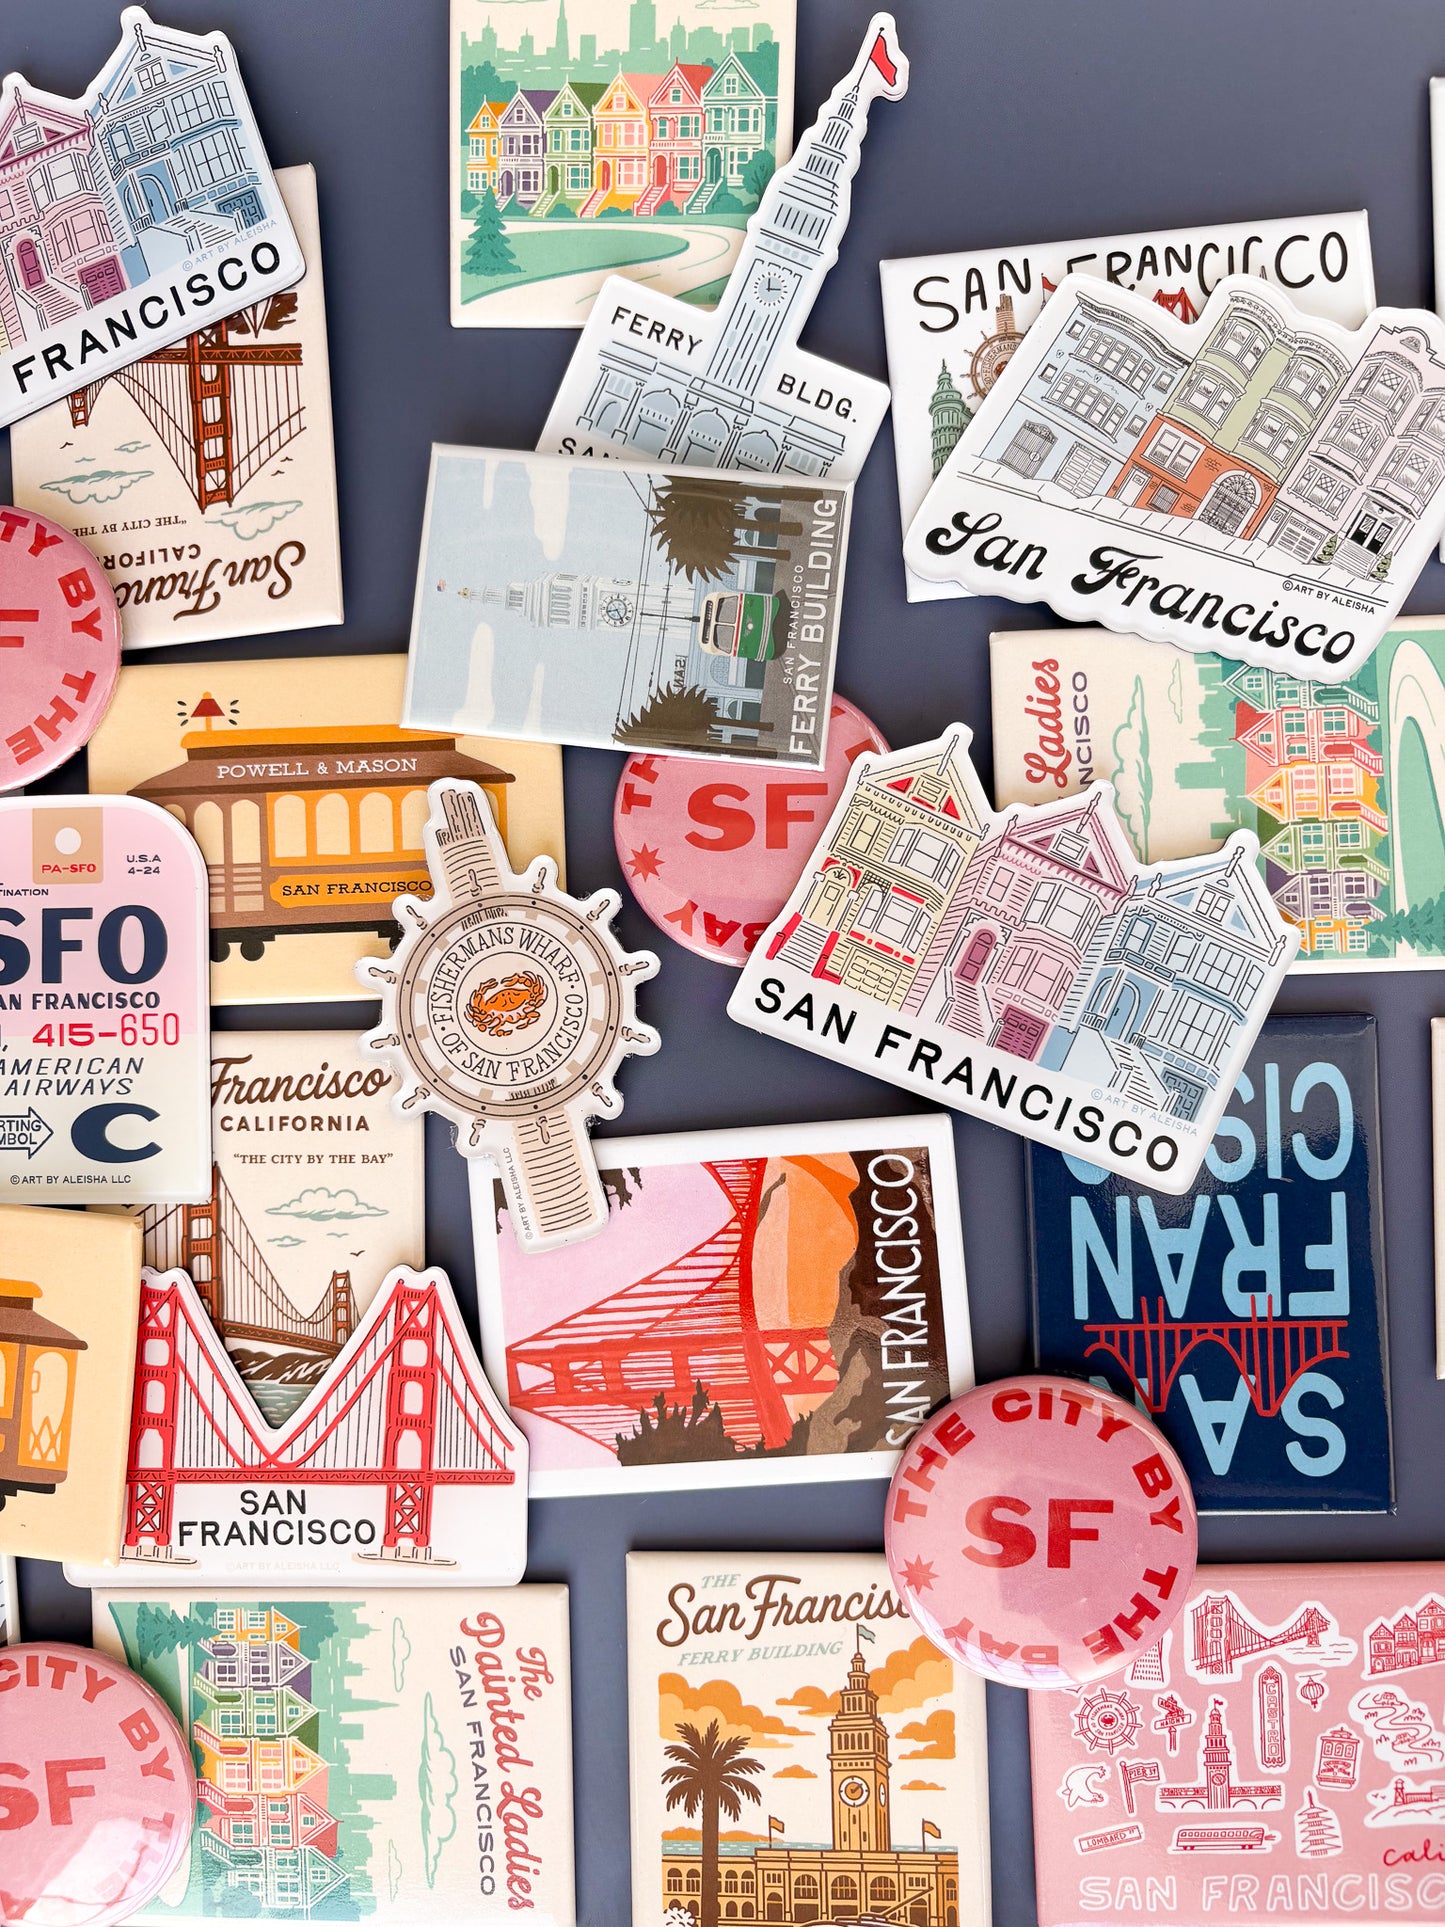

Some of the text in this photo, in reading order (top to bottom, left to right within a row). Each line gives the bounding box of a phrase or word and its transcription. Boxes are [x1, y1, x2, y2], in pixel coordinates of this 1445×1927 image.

[196, 250, 214, 264] ART
[217, 242, 230, 253] BY
[234, 220, 277, 245] ALEISHA
[913, 257, 1031, 333] SAN
[12, 242, 280, 394] FRANCISCO
[611, 306, 703, 356] FERRY
[777, 374, 858, 423] BLDG.
[558, 437, 620, 460] SA
[73, 525, 97, 538] THE
[101, 523, 117, 534] BY
[121, 519, 151, 530] CITY
[97, 543, 201, 570] CALIFOR
[223, 540, 307, 600] San
[58, 567, 103, 642] BY
[925, 510, 1356, 664] San Francisco
[1316, 591, 1330, 601] BY
[1331, 596, 1375, 614] ALEISHA
[783, 564, 804, 684] SAN FRANCISCO
[789, 499, 838, 755] FERRY BUILDING
[5, 670, 97, 766] THE
[1024, 658, 1072, 789] Ladies
[1072, 671, 1095, 786] NCISCO
[217, 758, 418, 780] POWELL & MASON
[684, 782, 829, 852] SF
[41, 863, 97, 874] PA-SFO
[127, 854, 162, 864] U.S.A
[128, 866, 161, 876] 4-24
[282, 880, 432, 897] SAN FRANCISCO
[431, 927, 580, 1025] FISHERMANS WHARF
[32, 992, 160, 1010] FRANCISCO
[32, 1012, 180, 1047] 415-650
[441, 994, 584, 1082] OF SAN FRANCISCO
[4, 1078, 134, 1097] AIRWAYS
[211, 1053, 392, 1109] Francisco
[754, 977, 1180, 1173] SAN FRANCISCO
[70, 1102, 163, 1164] C
[220, 1115, 370, 1132] CALIFORNIA
[1104, 1095, 1126, 1109] ART
[1131, 1104, 1147, 1116] BY
[1150, 1113, 1198, 1137] ALEISHA
[271, 1154, 303, 1164] CITY
[307, 1154, 324, 1164] BY
[329, 1154, 356, 1164] THE
[503, 1147, 513, 1163] LLC
[46, 1174, 60, 1184] BY
[62, 1174, 108, 1184] ALEISHA
[111, 1174, 132, 1184] LLC
[508, 1165, 523, 1200] ALEISHA
[518, 1202, 526, 1213] BY
[1071, 1191, 1351, 1321] FRAN
[866, 1153, 931, 1447] SAN FRANCISCO
[239, 1488, 307, 1516] SAN
[178, 1518, 377, 1547] FRANCISCO
[894, 1387, 1184, 1667] THE CITY BY THE BAY
[961, 1495, 1114, 1569] SF
[700, 1573, 741, 1590] THE
[656, 1582, 746, 1647] San
[516, 1646, 554, 1702] The
[677, 1641, 844, 1667] FERRY BUILDING
[1160, 1715, 1186, 1728] HAIGHT
[1265, 1682, 1280, 1757] CASTRO
[118, 1707, 175, 1782] BY
[460, 1611, 544, 1911] Painted Ladies
[450, 1646, 495, 1896] SAN FRANCISCO
[1129, 1766, 1148, 1779] PIER
[1086, 1832, 1127, 1848] LOMBARD
[1079, 1875, 1177, 1911] SAN
